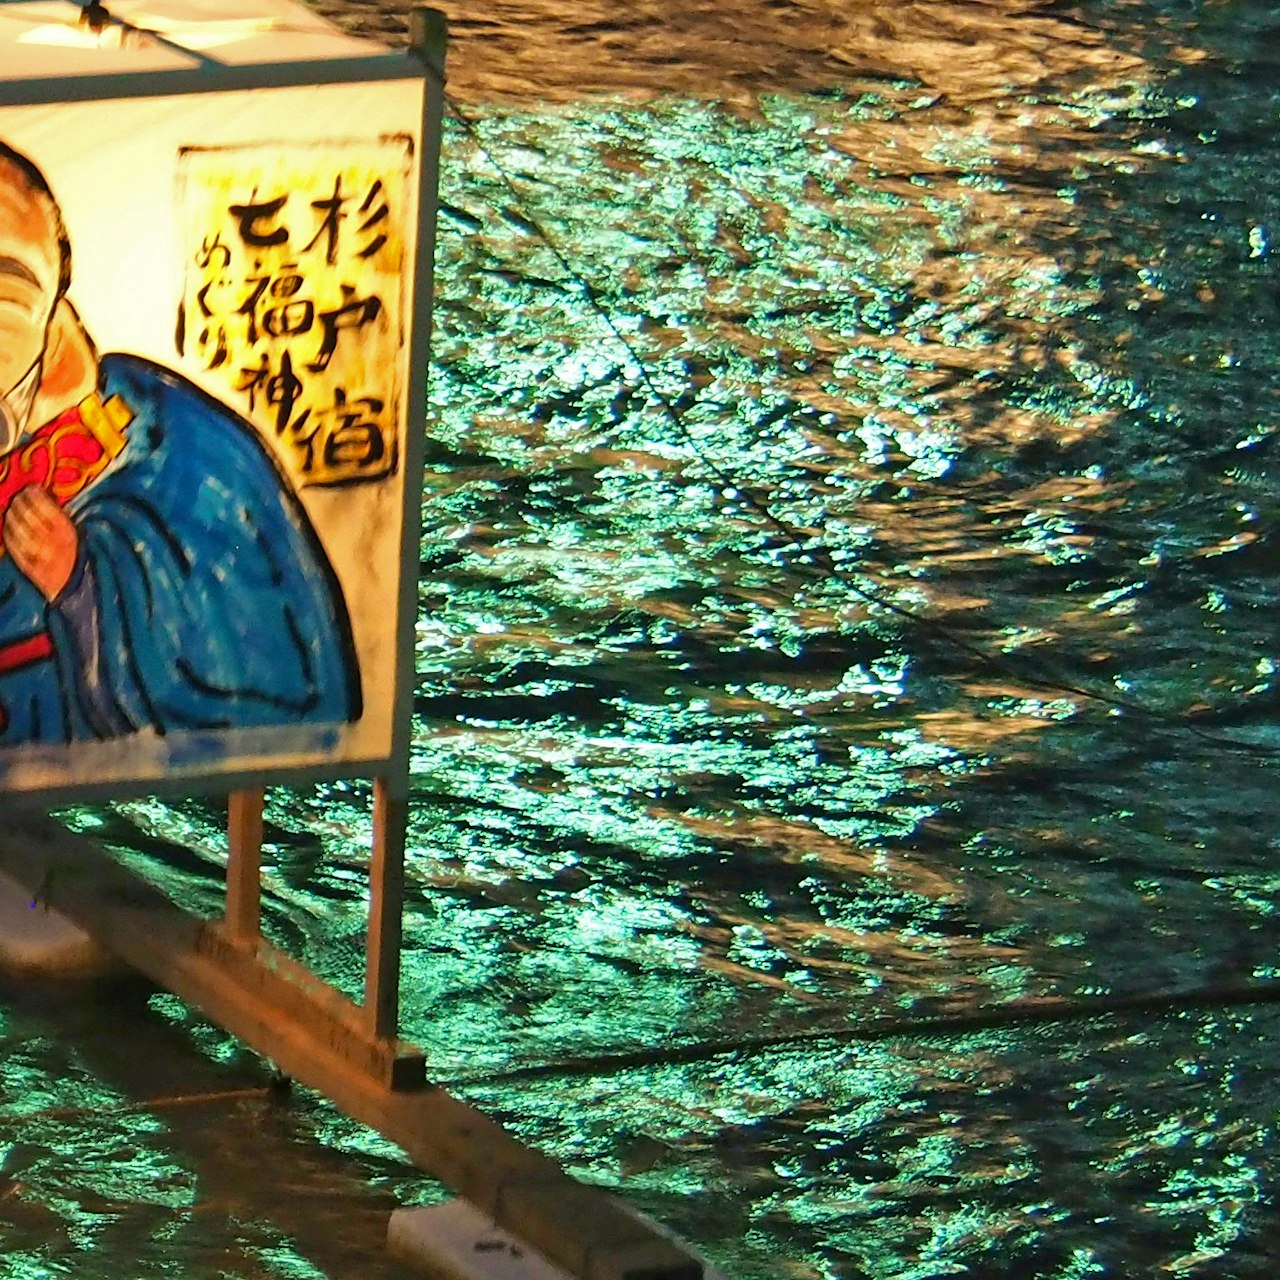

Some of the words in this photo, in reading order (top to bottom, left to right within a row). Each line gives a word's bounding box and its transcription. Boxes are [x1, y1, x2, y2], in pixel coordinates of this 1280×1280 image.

[228, 186, 314, 436] 七福神
[292, 173, 389, 472] 杉戸宿
